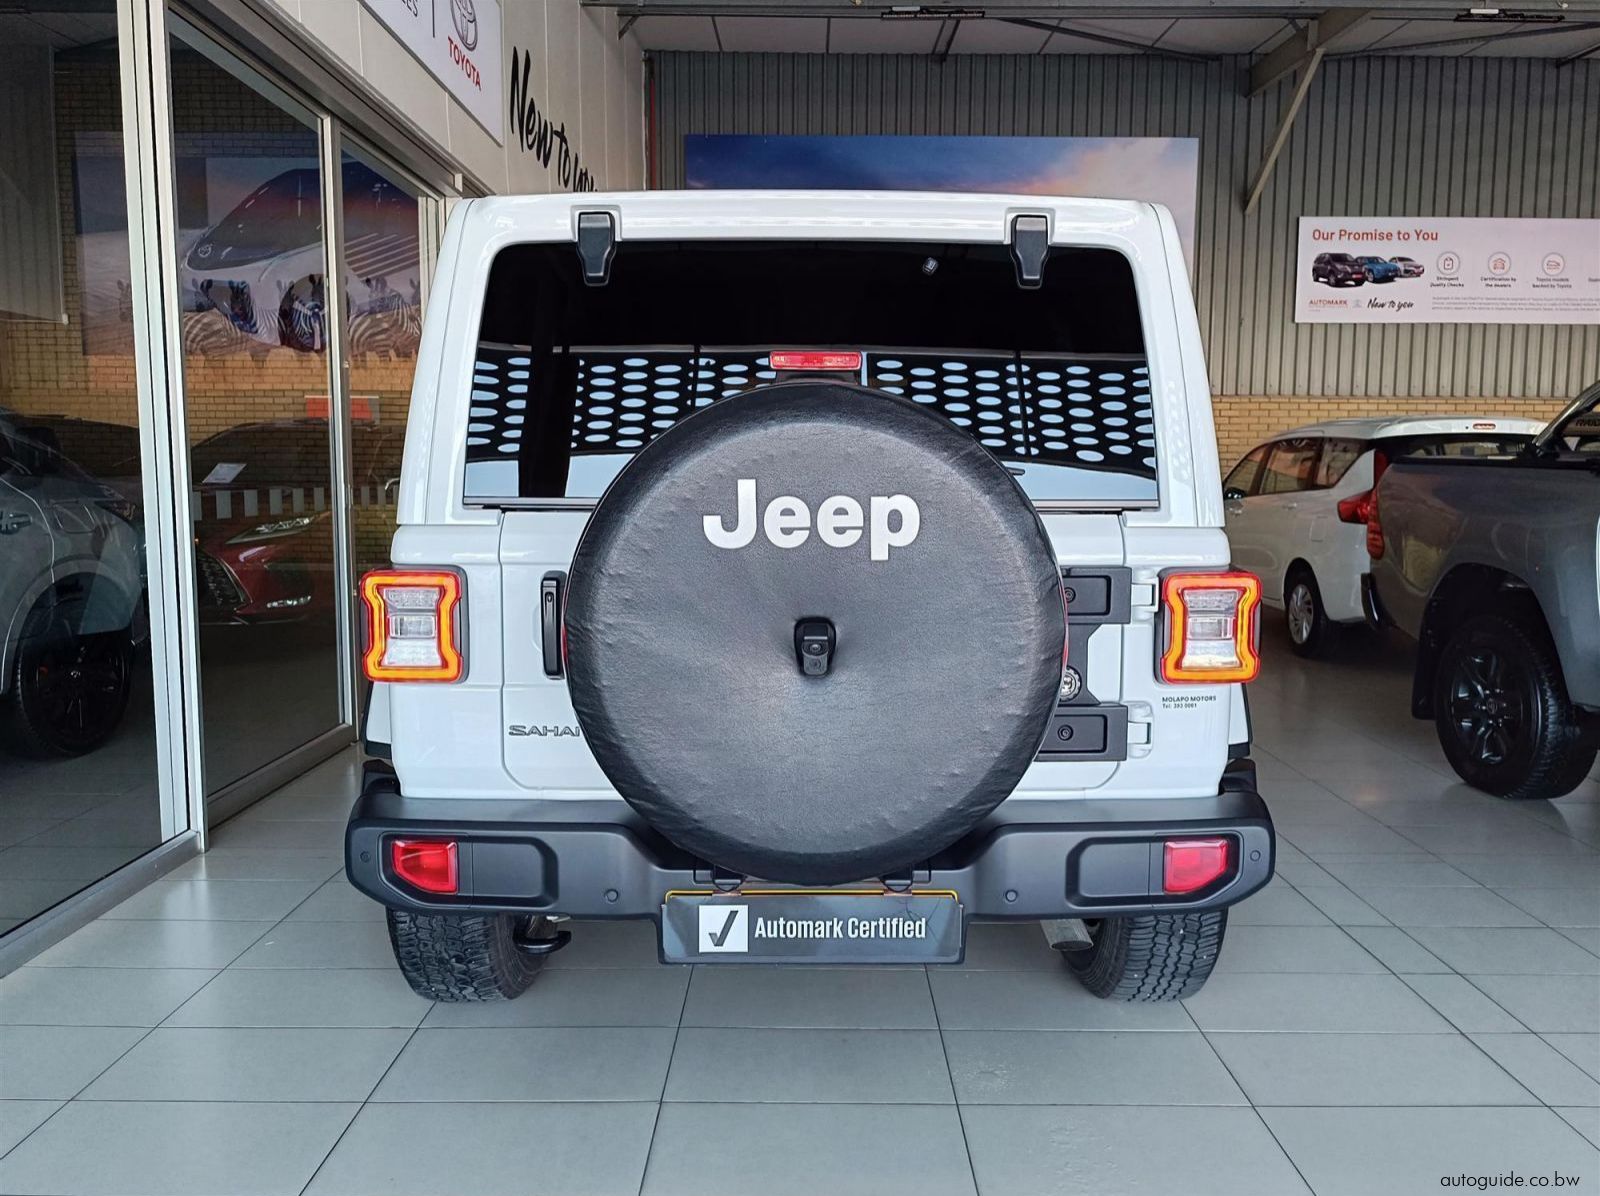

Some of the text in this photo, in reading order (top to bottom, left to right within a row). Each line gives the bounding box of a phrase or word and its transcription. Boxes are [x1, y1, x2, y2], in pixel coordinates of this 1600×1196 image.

[448, 35, 482, 92] TOYOTA
[509, 46, 553, 169] New
[553, 121, 571, 189] to
[1312, 229, 1439, 241] Our Promise to You
[1367, 297, 1414, 312] New to you
[703, 478, 920, 561] Jeep
[755, 917, 926, 939] Automark Certified
